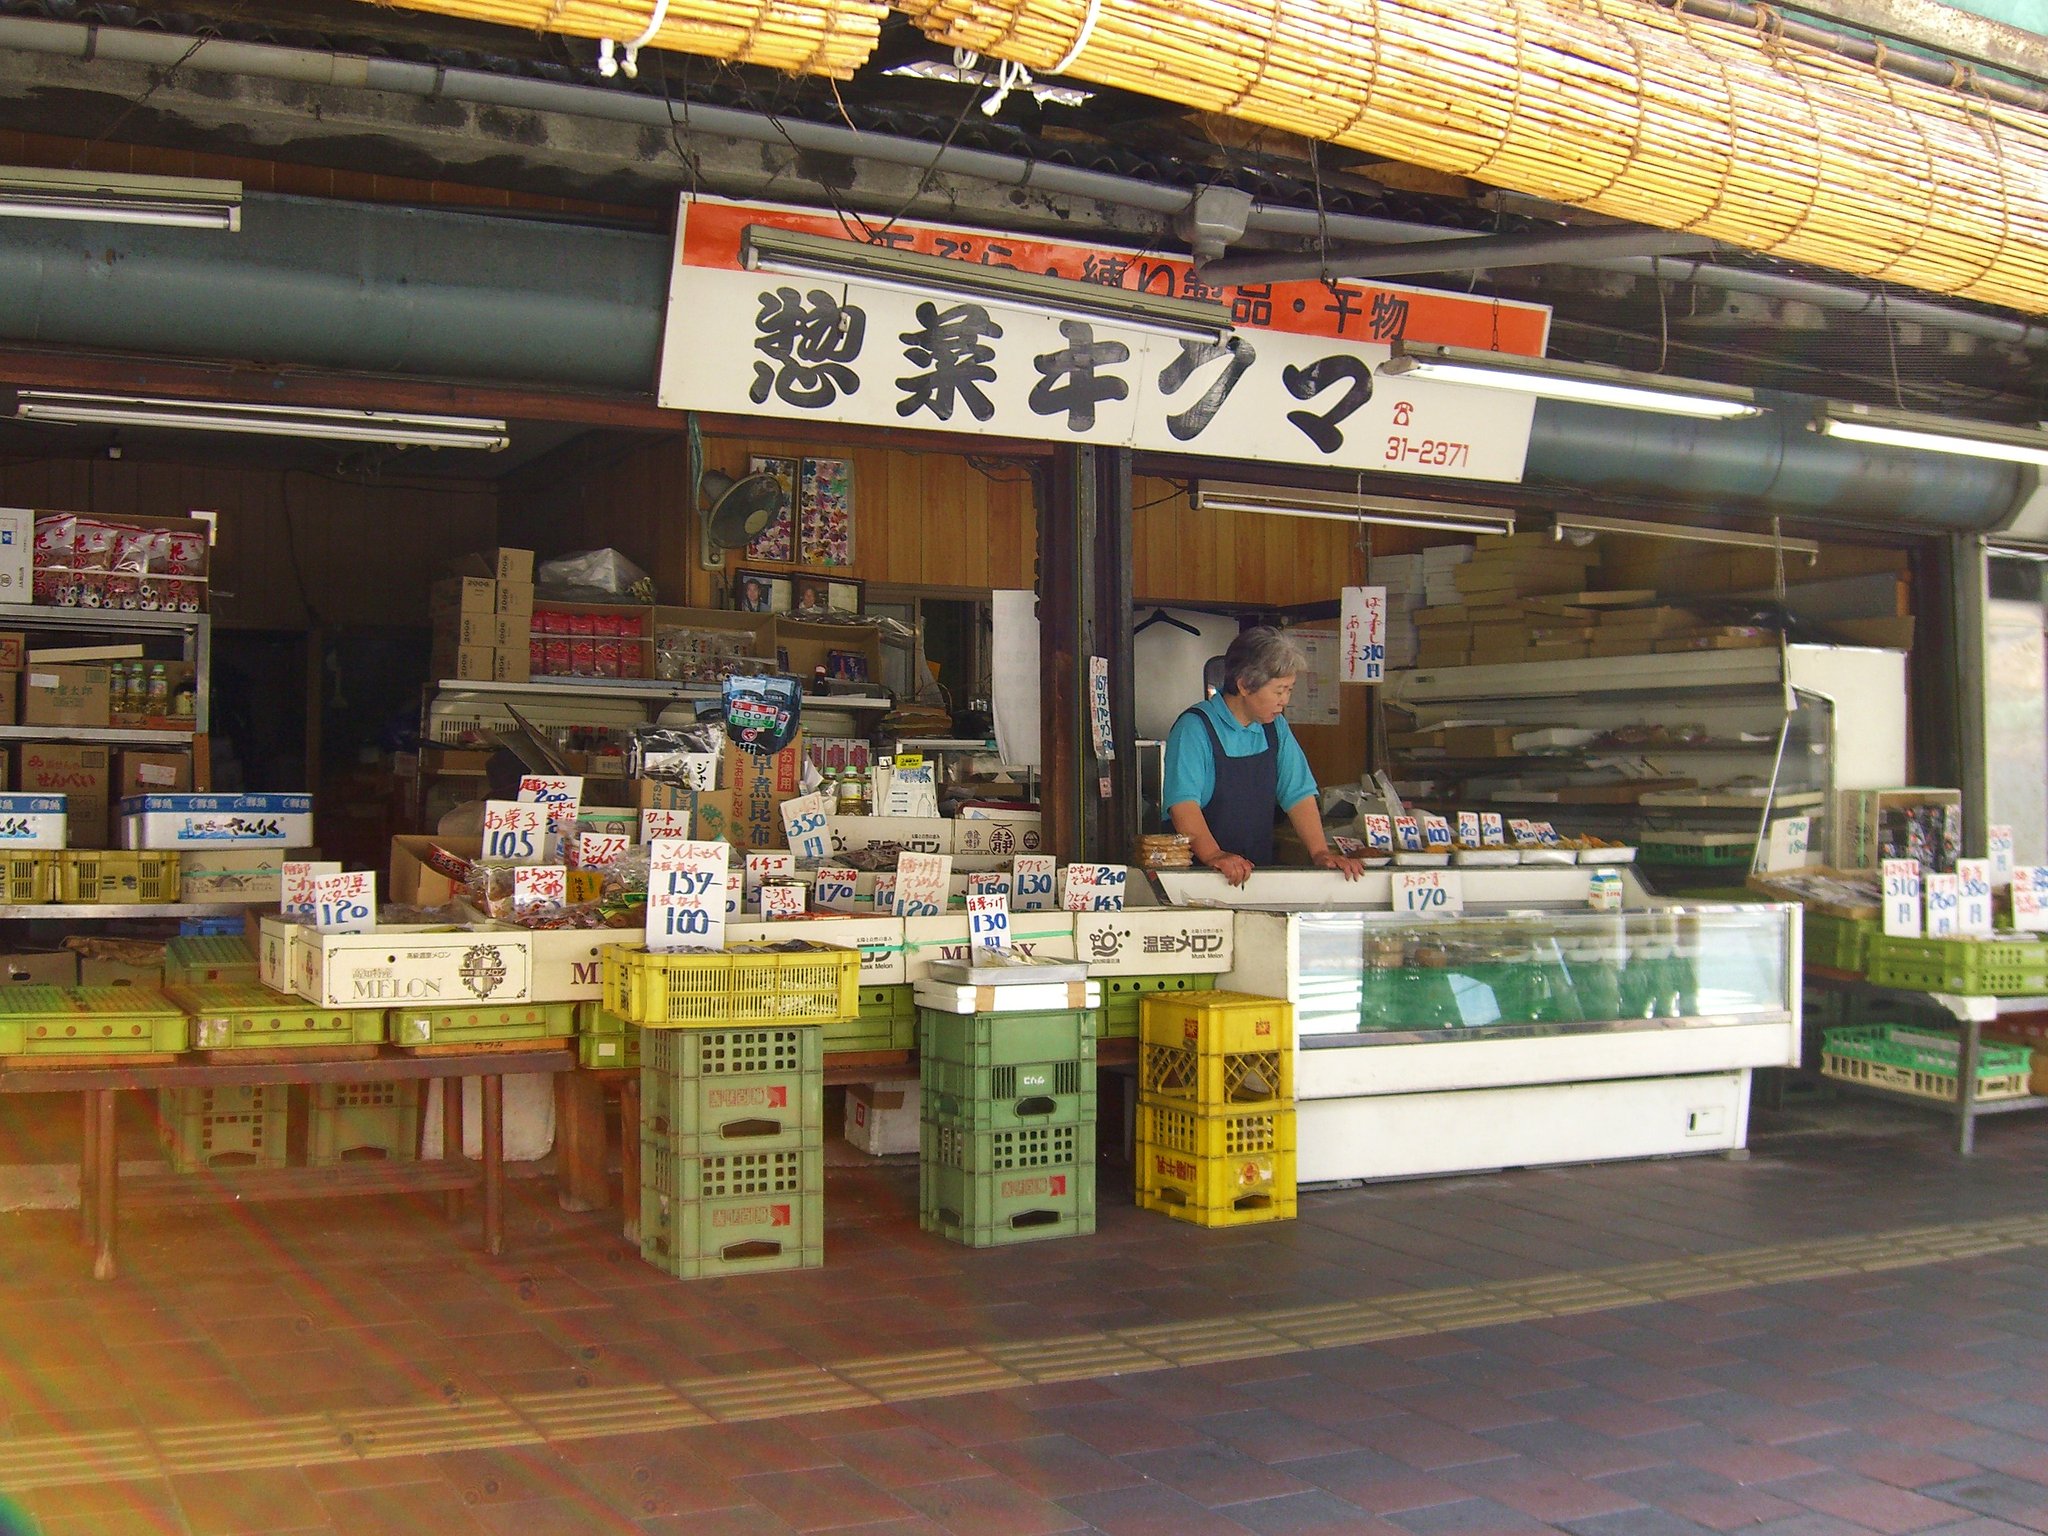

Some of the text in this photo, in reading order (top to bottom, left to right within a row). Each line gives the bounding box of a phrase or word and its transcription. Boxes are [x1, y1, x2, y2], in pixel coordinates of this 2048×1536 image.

[749, 286, 1374, 454] 惣菜キクマ
[1385, 435, 1470, 468] 31-2371
[1345, 614, 1360, 679] あります
[1359, 644, 1383, 661] 310
[1367, 663, 1380, 678] 円
[749, 754, 772, 846] 早煮昆布
[485, 809, 539, 831] お菓子
[645, 811, 675, 825] カット
[788, 813, 825, 837] 350
[651, 826, 682, 839] ワカメ
[490, 830, 534, 858] 105
[583, 837, 626, 854] ミックス
[661, 843, 723, 860] こんにゃく
[804, 836, 824, 858] 円
[991, 831, 1014, 855] 静
[750, 856, 788, 871] イチゴ
[1017, 874, 1052, 896] 130
[1096, 867, 1126, 886] 240
[528, 881, 564, 895] 太郎
[765, 888, 792, 901] こうや
[819, 884, 853, 902] 170
[1887, 878, 1919, 897] 310
[322, 900, 368, 925] 120
[897, 899, 938, 916] 120
[1094, 895, 1123, 912] 145
[973, 913, 1007, 933] 130
[1143, 934, 1223, 954] 温室メロン
[353, 977, 443, 1000] MELON
